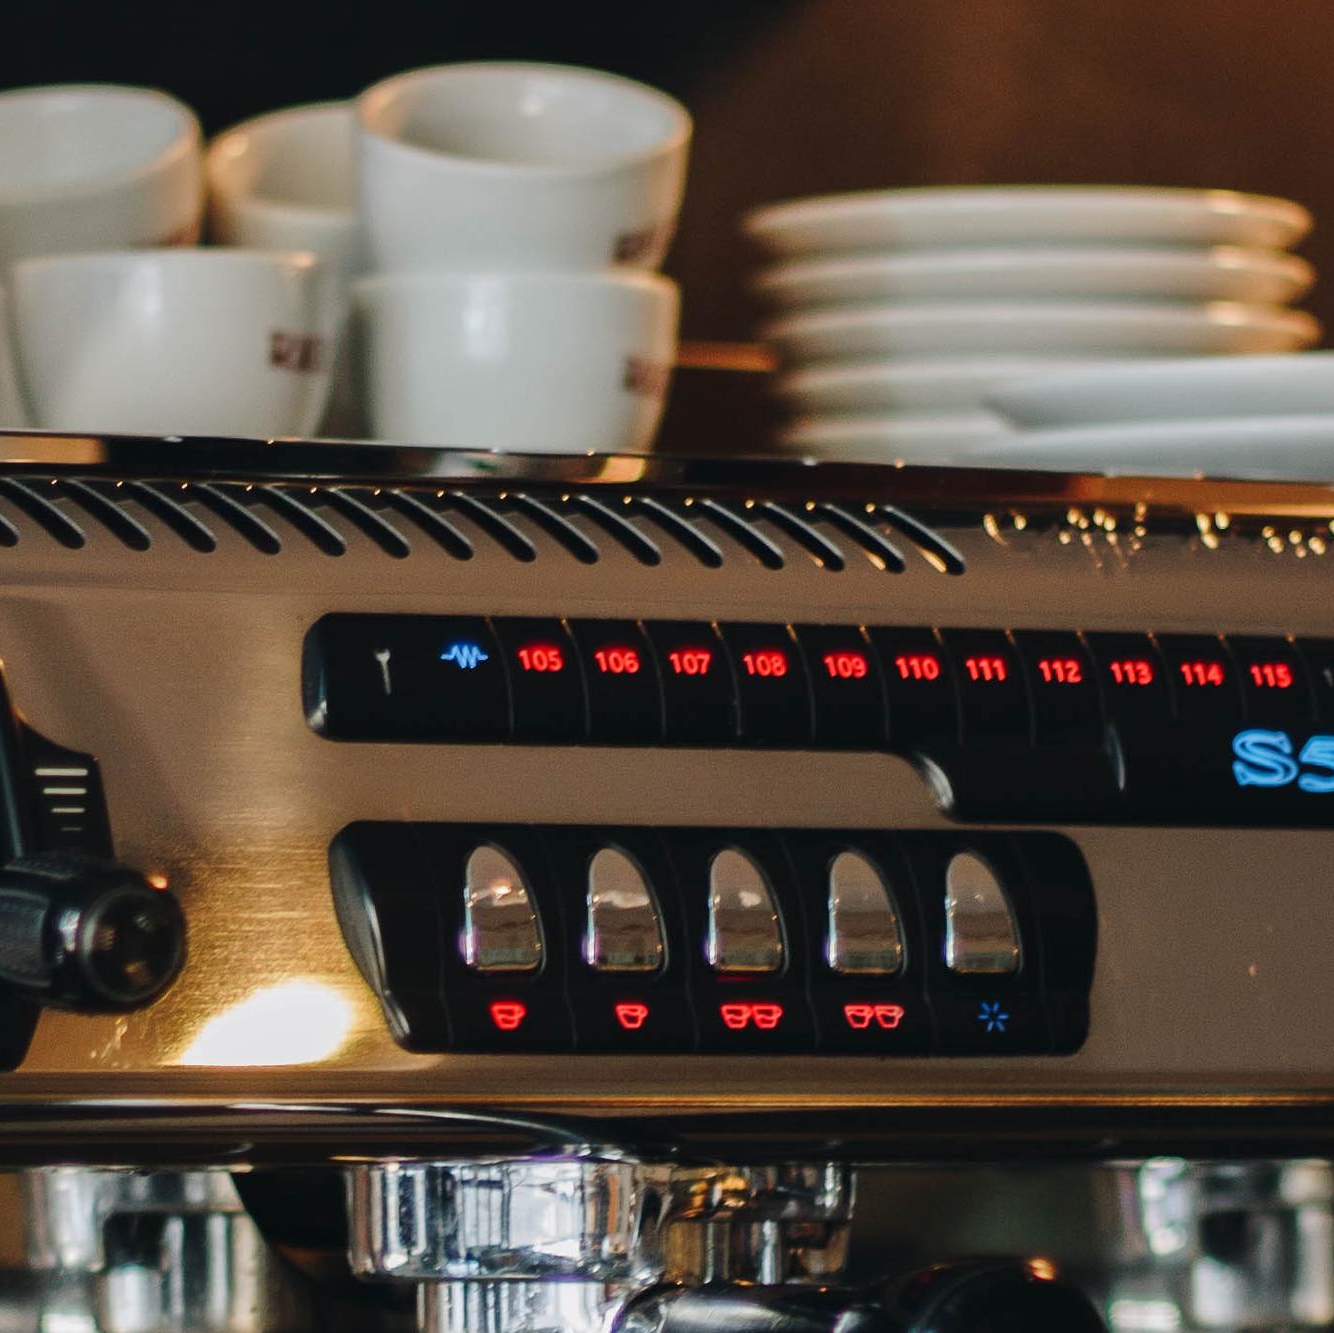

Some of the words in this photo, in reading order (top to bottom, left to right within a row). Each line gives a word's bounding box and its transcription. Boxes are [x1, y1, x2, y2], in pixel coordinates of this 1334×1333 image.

[518, 645, 564, 672] 105
[594, 647, 640, 674] 106
[668, 649, 712, 676] 107
[742, 650, 788, 677] 108
[823, 652, 868, 679] 109
[895, 655, 940, 681] 110
[965, 656, 1007, 681] 111
[1038, 658, 1082, 684] 112
[1110, 659, 1154, 686] 113
[1180, 661, 1224, 686] 114
[1250, 663, 1293, 689] 115
